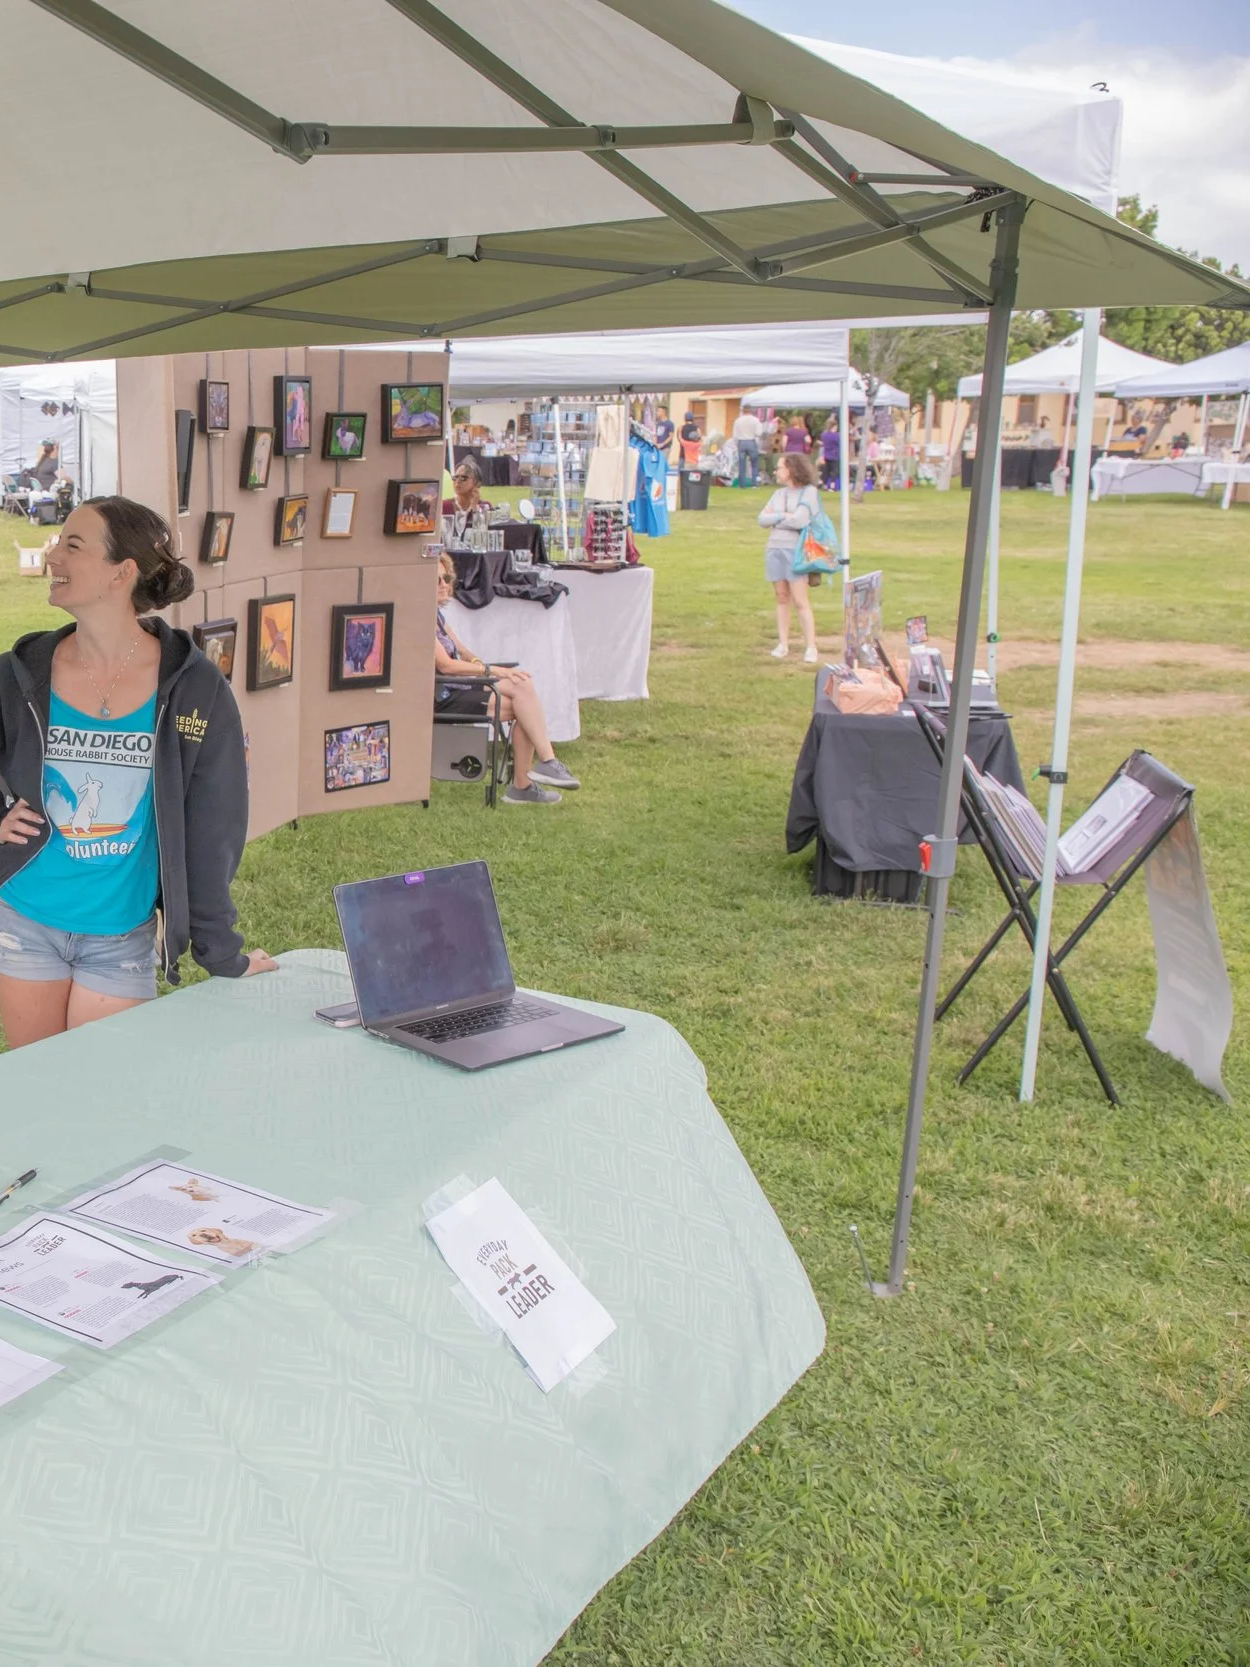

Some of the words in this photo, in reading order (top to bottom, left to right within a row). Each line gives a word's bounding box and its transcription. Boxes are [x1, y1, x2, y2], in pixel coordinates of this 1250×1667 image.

[175, 715, 208, 728] EDING
[175, 723, 206, 736] ERICA
[46, 728, 88, 747] SAN
[90, 734, 152, 752] DIEGO
[75, 750, 109, 761] RABBIT
[111, 752, 151, 765] SOCIETY
[65, 839, 136, 859] olunteer
[37, 1236, 66, 1256] LEADER
[476, 1240, 508, 1266] EVERYDAY
[490, 1253, 518, 1280] PACK
[506, 1274, 555, 1319] LEADER
